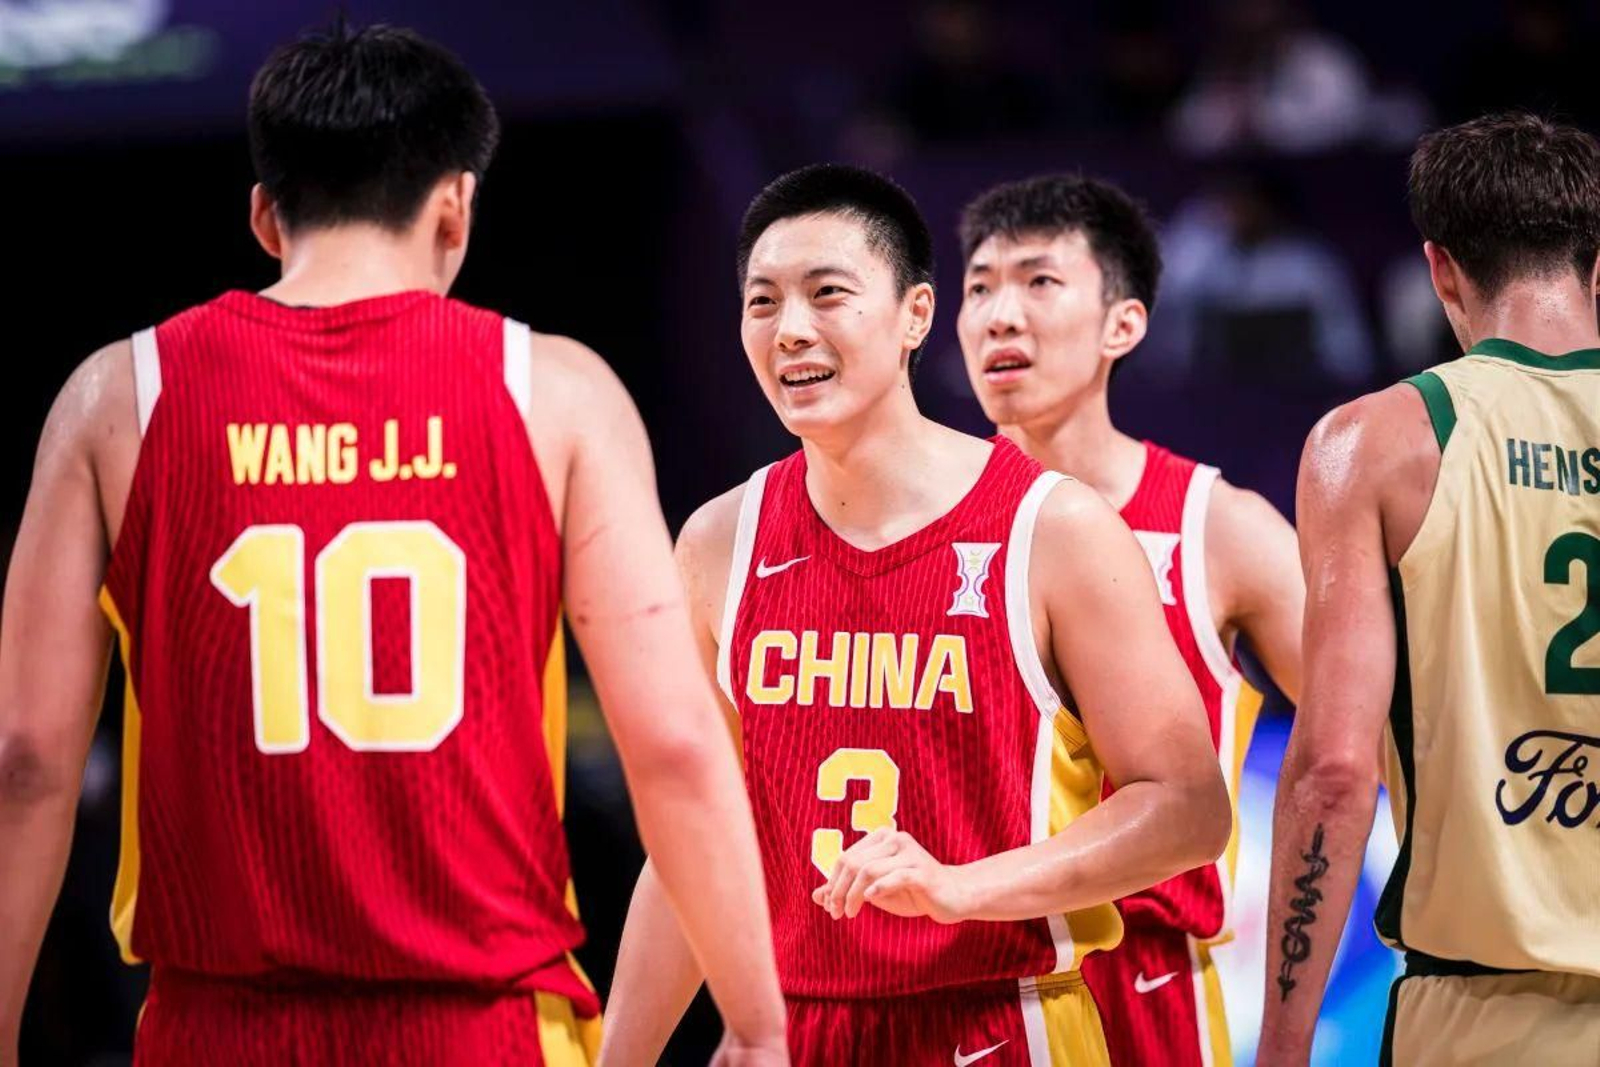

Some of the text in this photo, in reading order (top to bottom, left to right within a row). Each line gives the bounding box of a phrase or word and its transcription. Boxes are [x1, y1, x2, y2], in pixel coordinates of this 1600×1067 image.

[226, 416, 457, 485] WANG J.J.
[1506, 438, 1600, 496] HENS
[209, 520, 467, 755] 10
[746, 630, 974, 714] CHINA
[811, 747, 900, 880] 3
[1495, 730, 1600, 828] Fo
